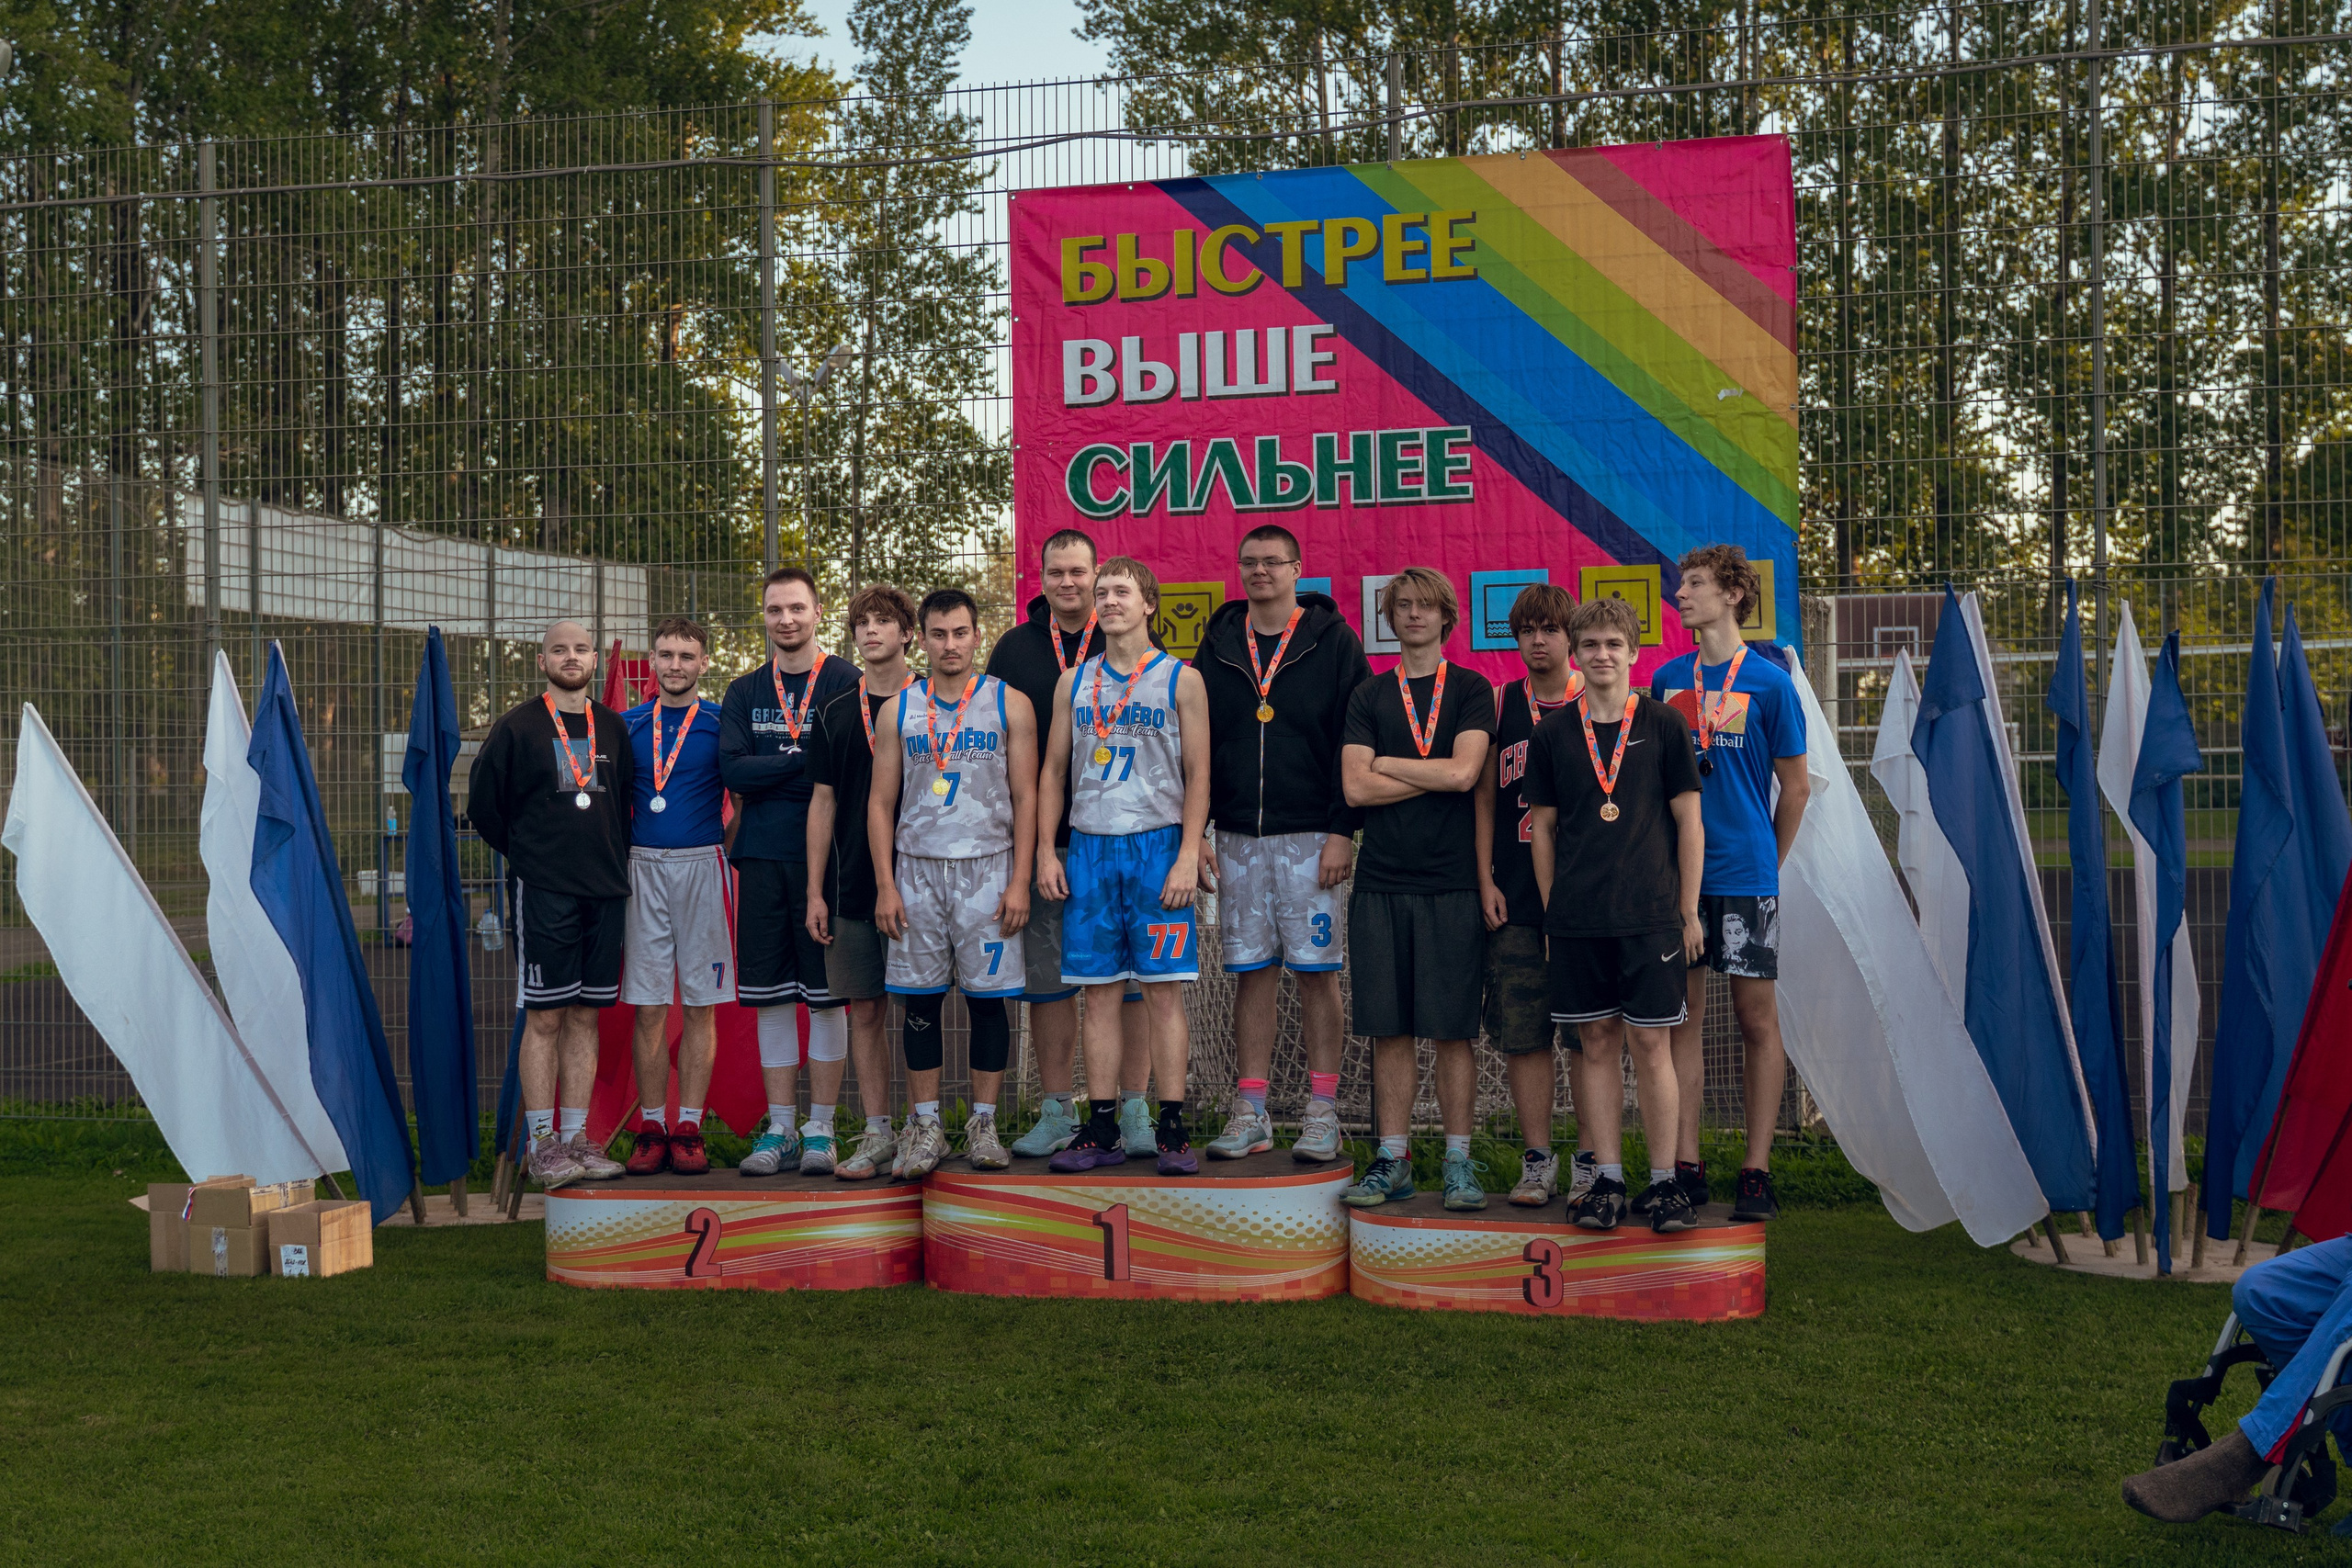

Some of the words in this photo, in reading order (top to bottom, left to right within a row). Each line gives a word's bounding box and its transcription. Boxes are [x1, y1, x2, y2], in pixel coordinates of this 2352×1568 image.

[1061, 210, 1477, 307] БЫСТРЕЕ
[1063, 323, 1339, 407] ВЫШЕ
[1066, 425, 1474, 521] СИЛЬНЕЕ
[1130, 723, 1159, 738] Team
[964, 748, 995, 762] Team
[1101, 745, 1136, 782] 77
[942, 772, 961, 807] 7
[1147, 921, 1189, 959] 77
[1310, 912, 1332, 948] 3
[527, 963, 544, 987] 11
[712, 962, 725, 989] 7
[984, 942, 1004, 976] 7
[684, 1207, 722, 1278] 2
[1092, 1202, 1131, 1280] 1
[1522, 1237, 1564, 1308] 3
